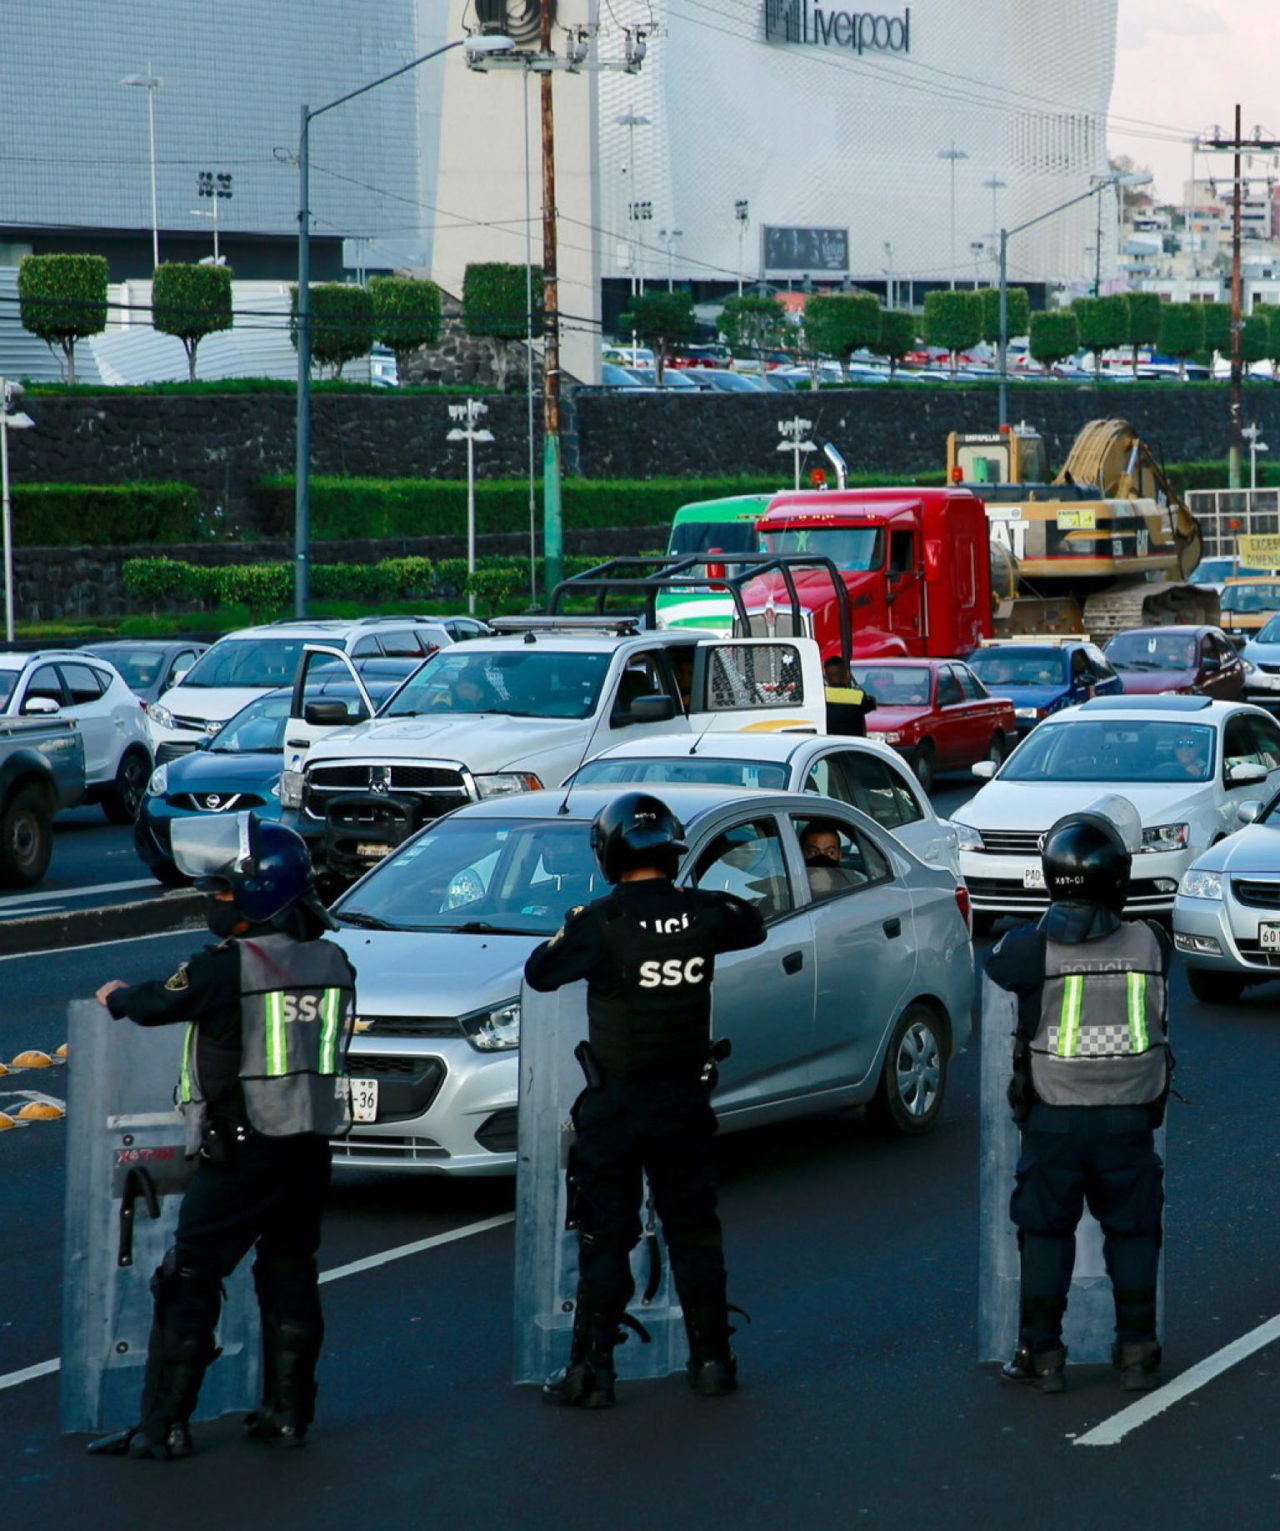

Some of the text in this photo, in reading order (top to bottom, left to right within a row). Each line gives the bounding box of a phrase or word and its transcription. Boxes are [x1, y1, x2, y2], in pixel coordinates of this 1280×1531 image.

[803, 0, 909, 55] Liverpool
[989, 520, 1030, 560] AT
[639, 957, 705, 988] SSC
